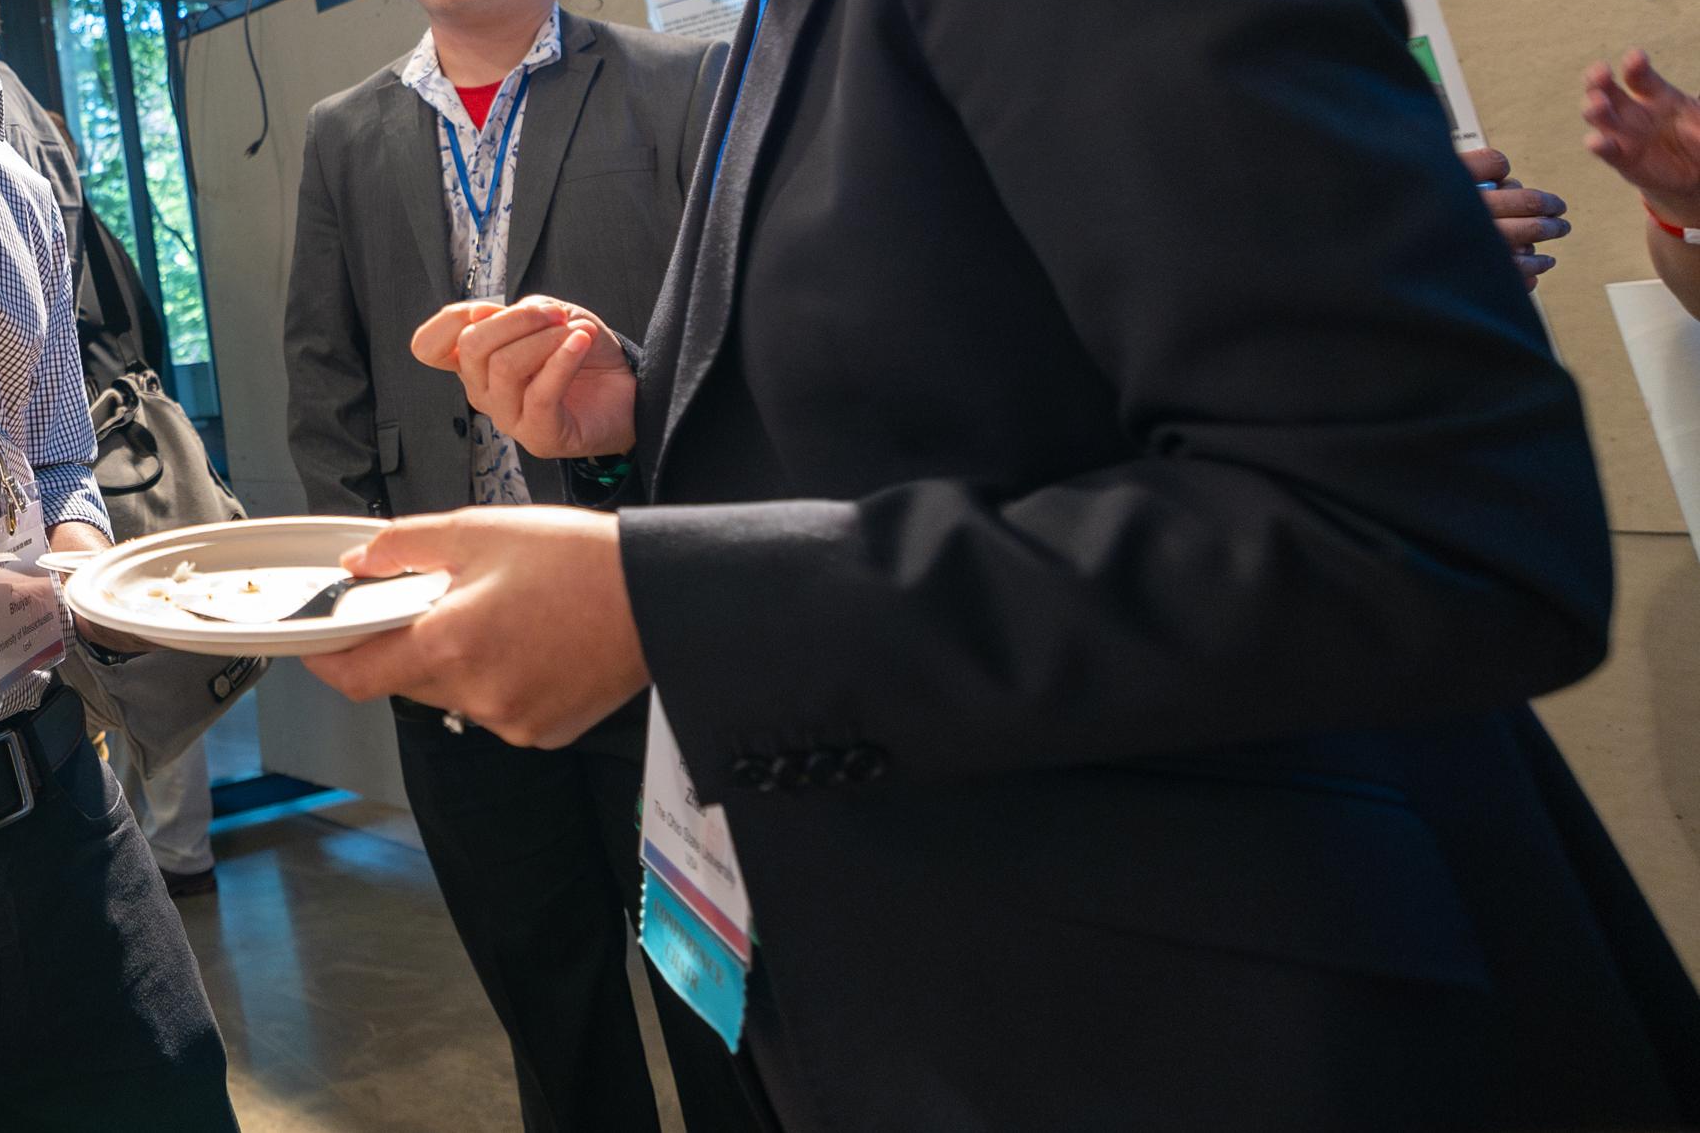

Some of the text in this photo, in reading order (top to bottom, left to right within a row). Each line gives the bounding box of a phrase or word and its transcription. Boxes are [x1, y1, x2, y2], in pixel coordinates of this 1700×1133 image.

[17, 627, 23, 641] of
[21, 610, 55, 638] Massachusetts
[654, 799, 736, 889] The Ohio State University
[653, 897, 724, 989] CONFERENCE
[663, 940, 699, 992] CHAIR
